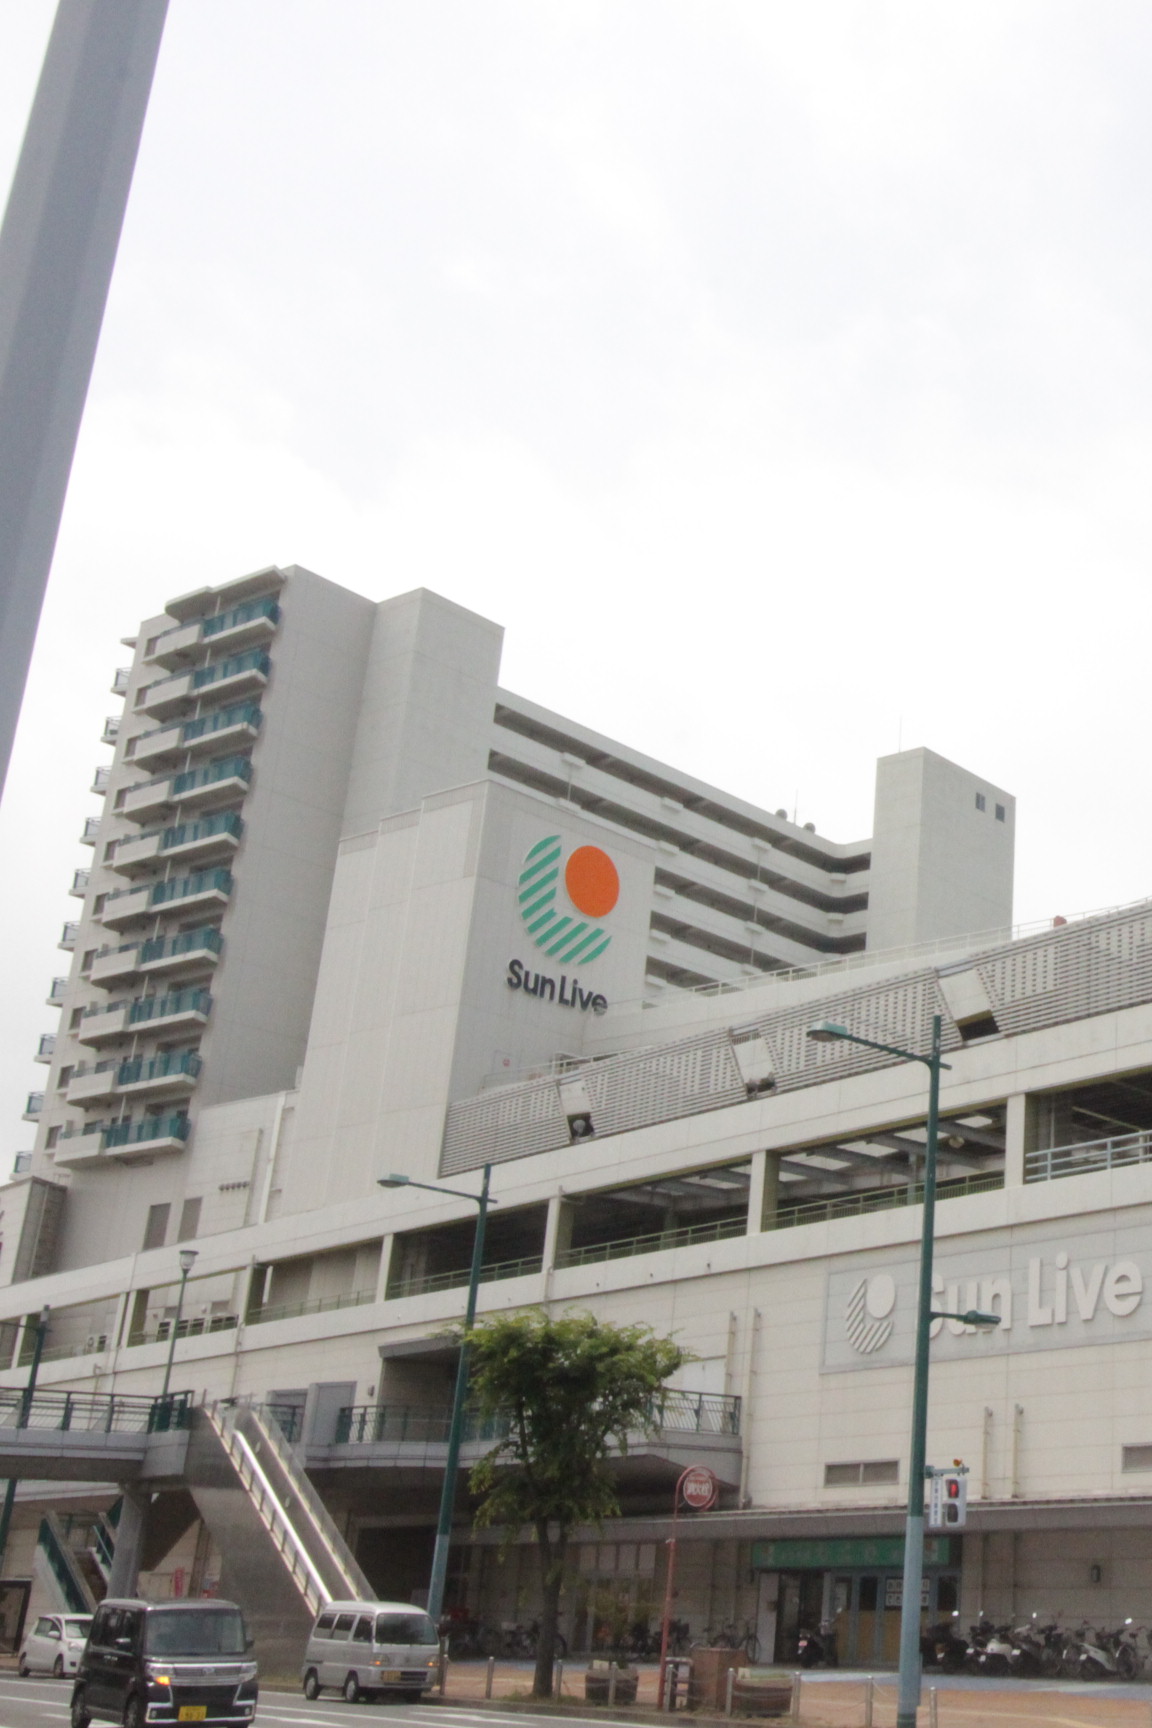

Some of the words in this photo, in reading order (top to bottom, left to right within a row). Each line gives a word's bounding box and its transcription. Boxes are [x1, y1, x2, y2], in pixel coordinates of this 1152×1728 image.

[507, 959, 556, 1002] Sun
[558, 974, 608, 1016] Live
[1028, 1251, 1144, 1328] Live
